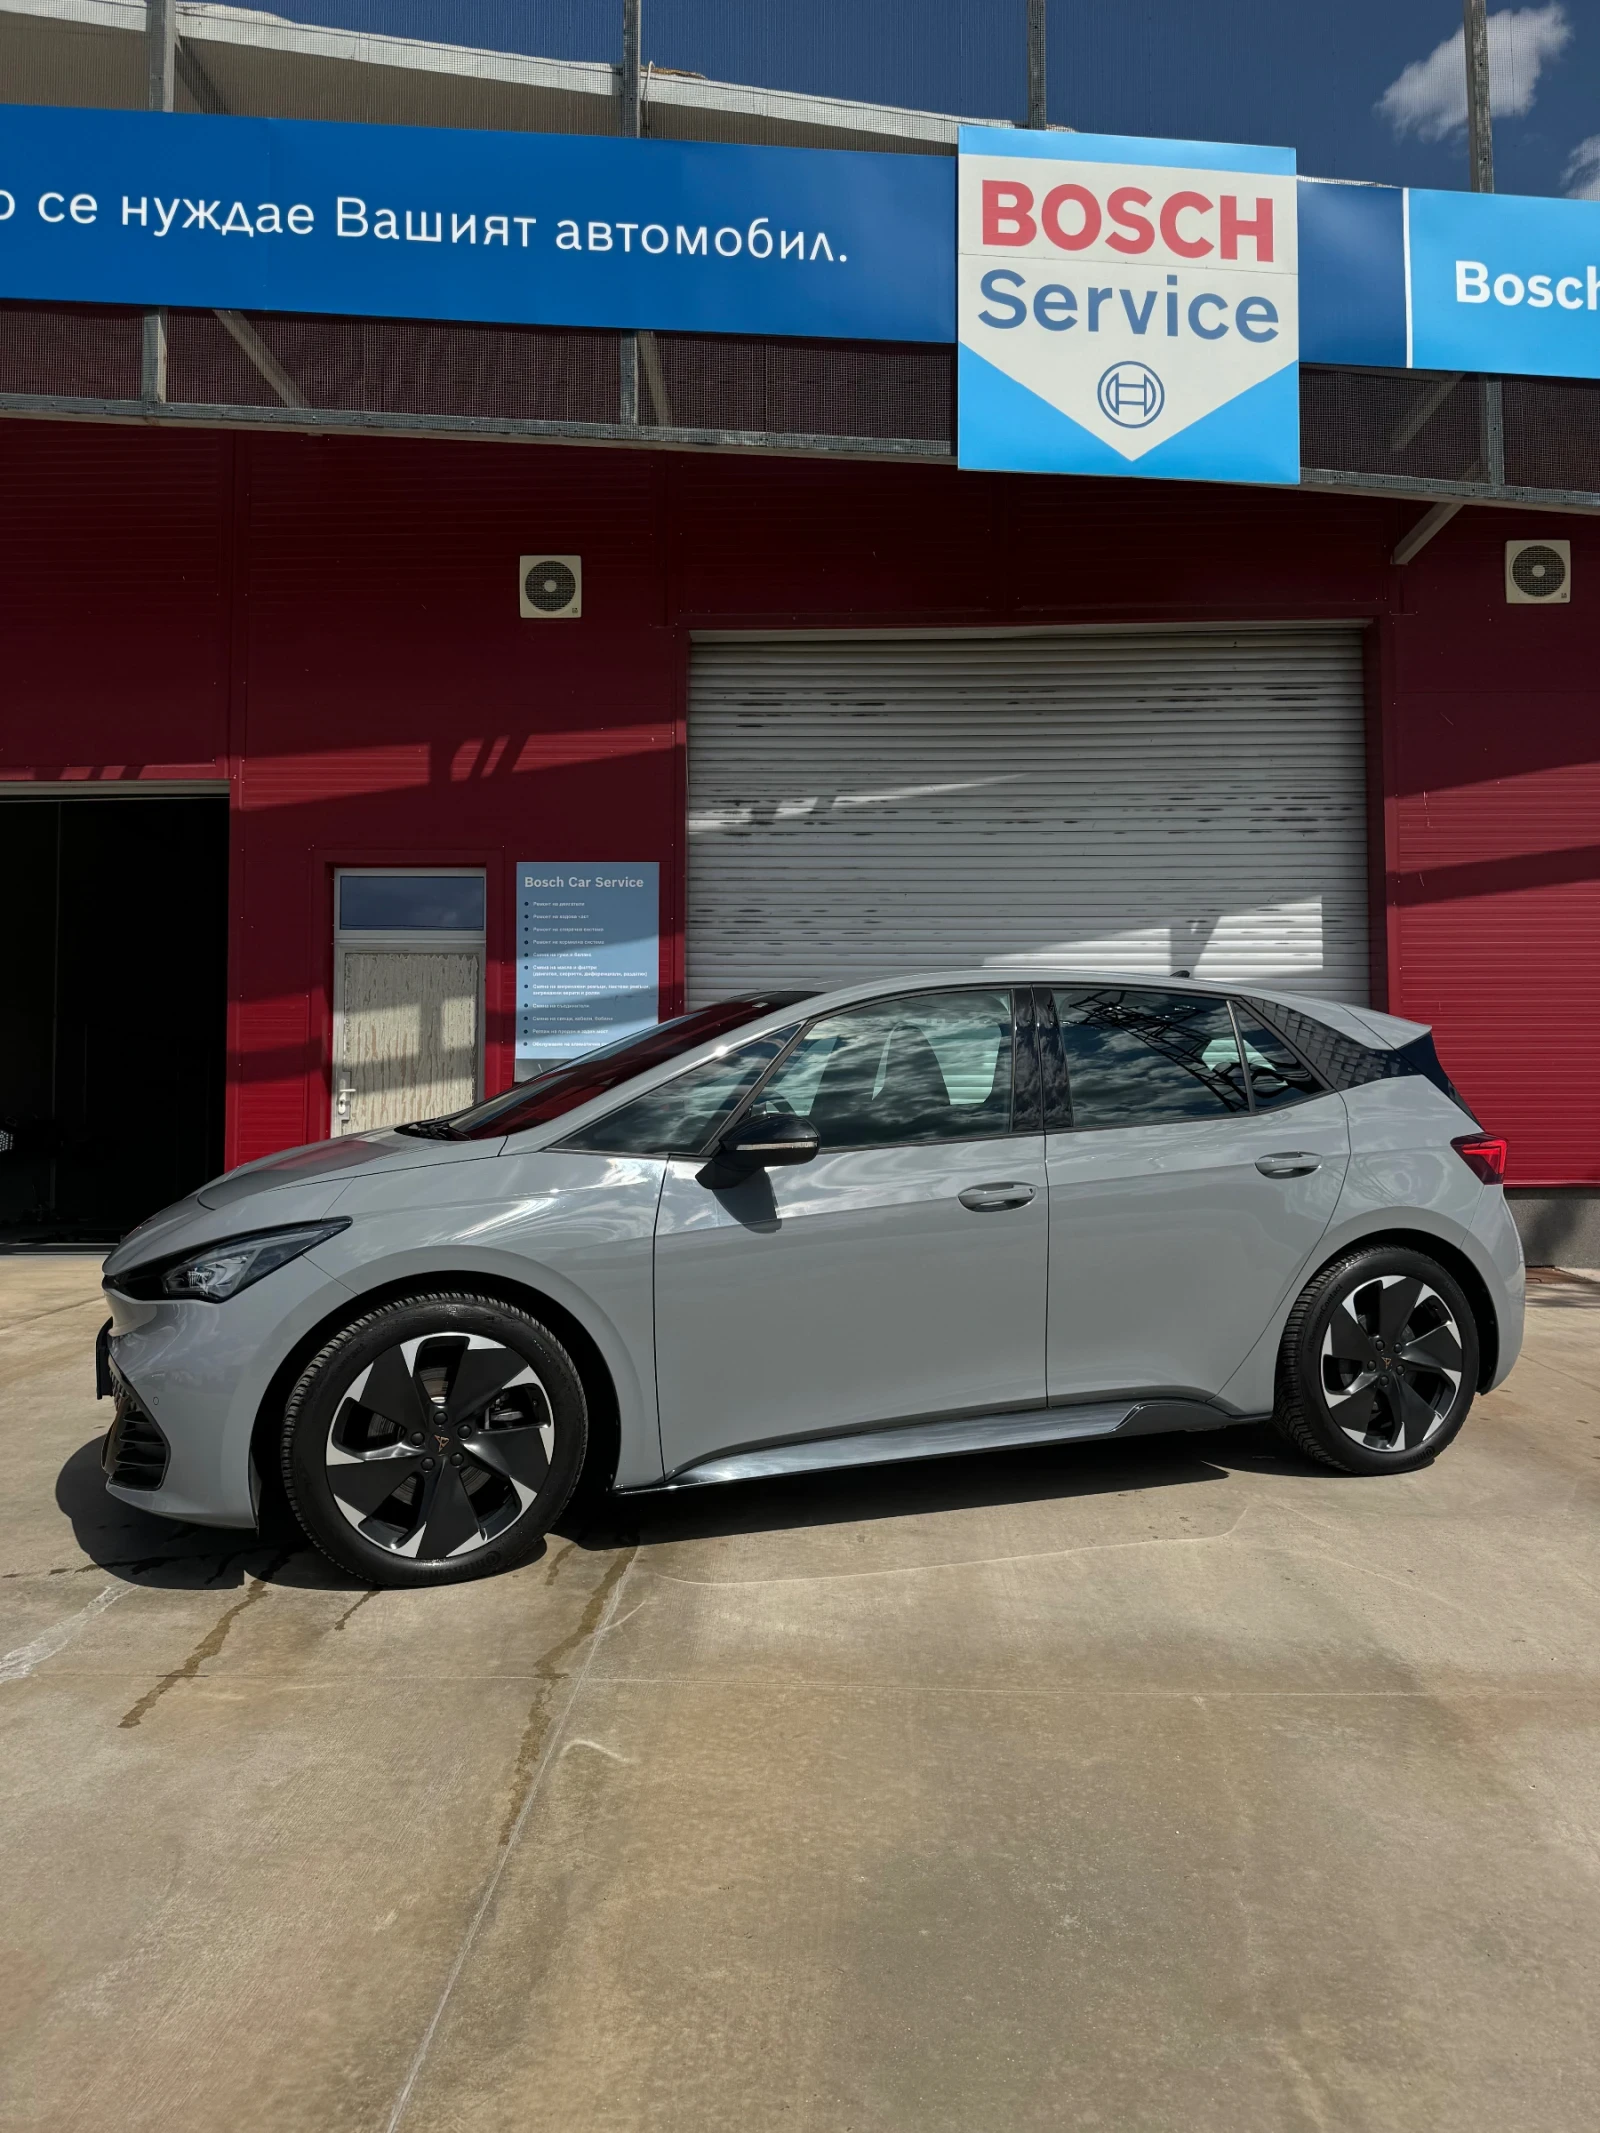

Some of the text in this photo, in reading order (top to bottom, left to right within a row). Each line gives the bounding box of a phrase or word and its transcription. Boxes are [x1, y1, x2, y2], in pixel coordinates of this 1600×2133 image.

[38, 192, 98, 224] се
[122, 195, 315, 238] нуждае
[336, 196, 537, 248] Вашият
[555, 217, 848, 263] автомобил.
[982, 180, 1274, 262] BOSCH
[978, 269, 1279, 343] Service
[524, 876, 644, 888] Bosch Car Service
